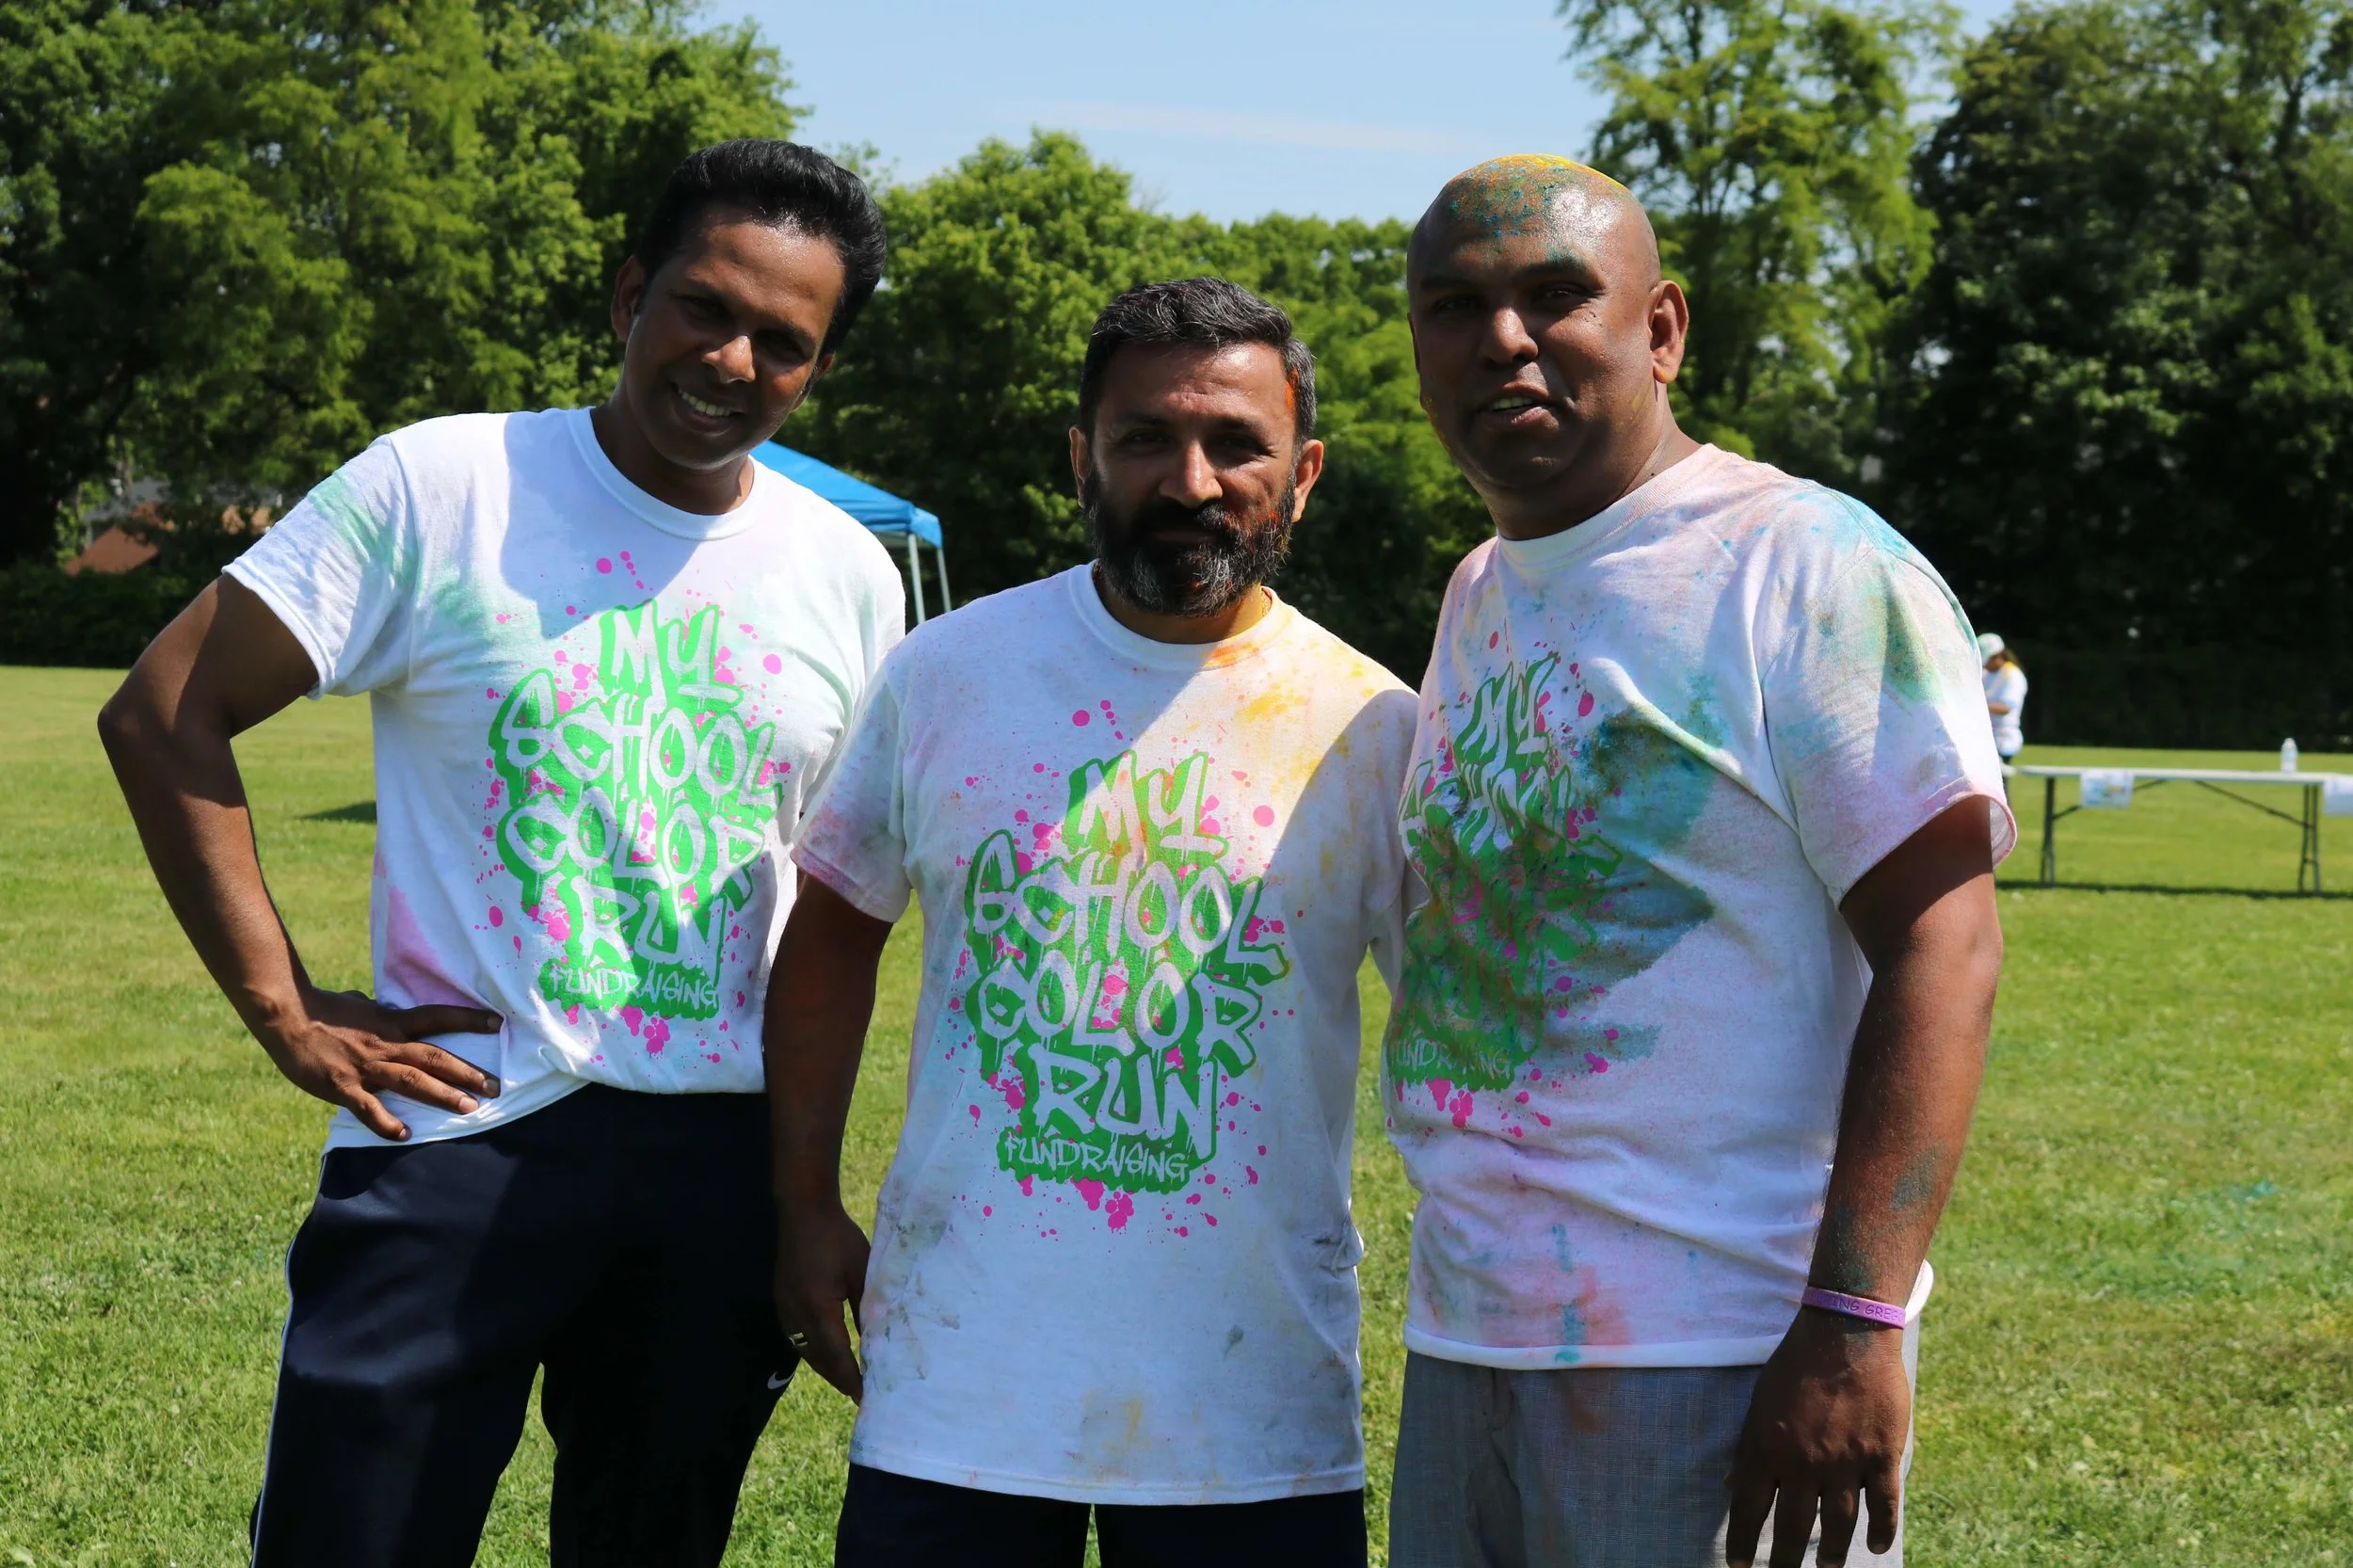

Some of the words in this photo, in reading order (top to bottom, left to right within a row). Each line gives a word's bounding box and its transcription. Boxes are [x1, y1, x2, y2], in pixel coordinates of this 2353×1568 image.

[607, 600, 741, 708] MY
[500, 672, 776, 807] SCHOOL
[504, 785, 764, 897] COLOR
[1076, 753, 1228, 864] MY
[569, 875, 723, 977] RUN
[972, 834, 1286, 975] SCHOOL
[548, 965, 720, 1010] FUNDRAISING
[979, 950, 1260, 1066] COLOR
[1032, 1043, 1217, 1158] RUN
[1004, 1132, 1190, 1183] FUNDRAISING
